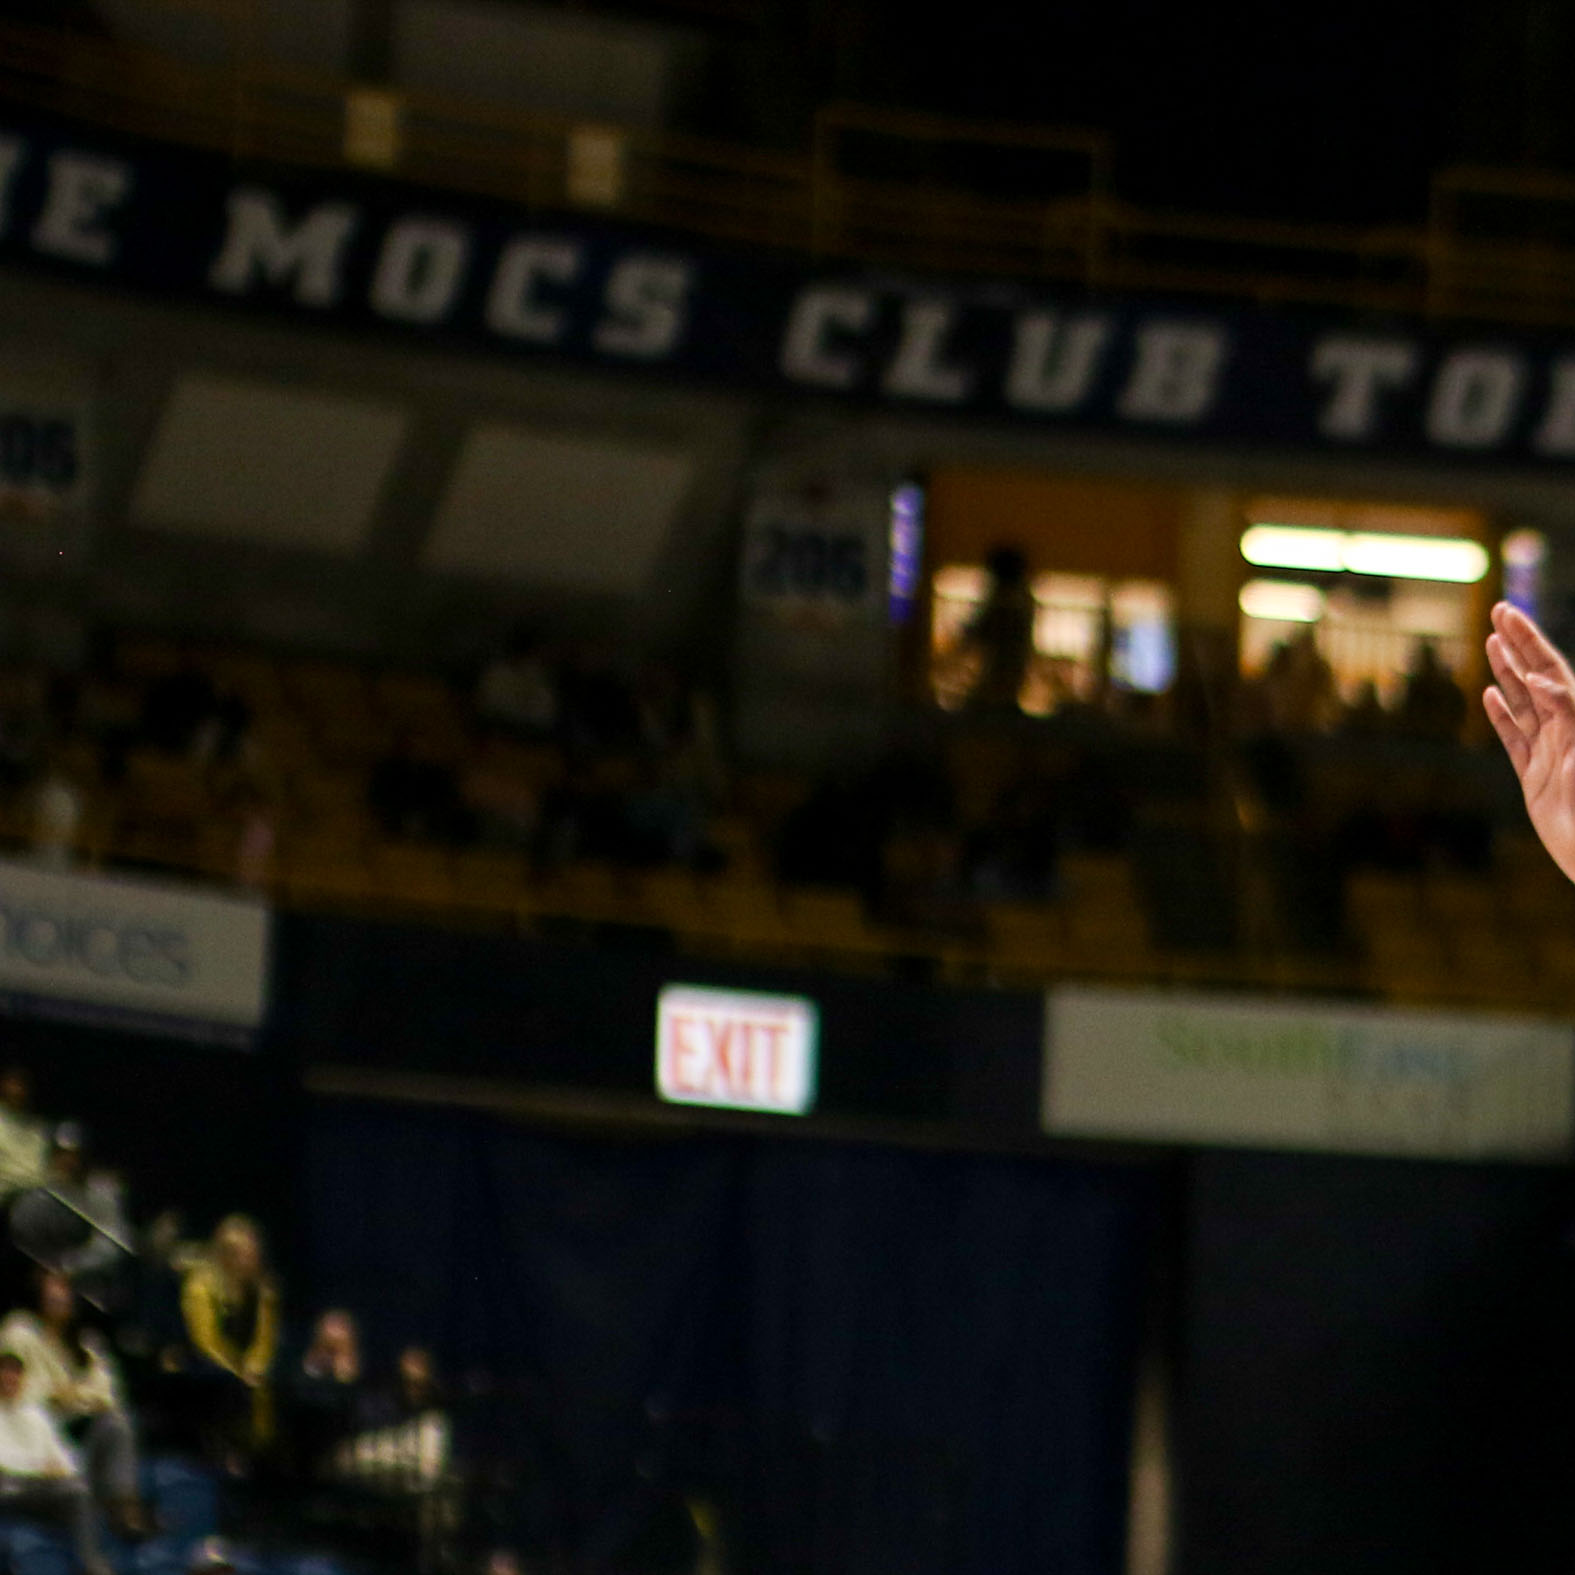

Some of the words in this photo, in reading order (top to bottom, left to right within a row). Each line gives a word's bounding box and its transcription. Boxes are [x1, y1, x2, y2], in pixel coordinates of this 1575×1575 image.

[0, 128, 134, 266] E
[207, 184, 695, 359] MOCS
[777, 283, 1232, 428] CLUB
[668, 1014, 791, 1102] EXIT
